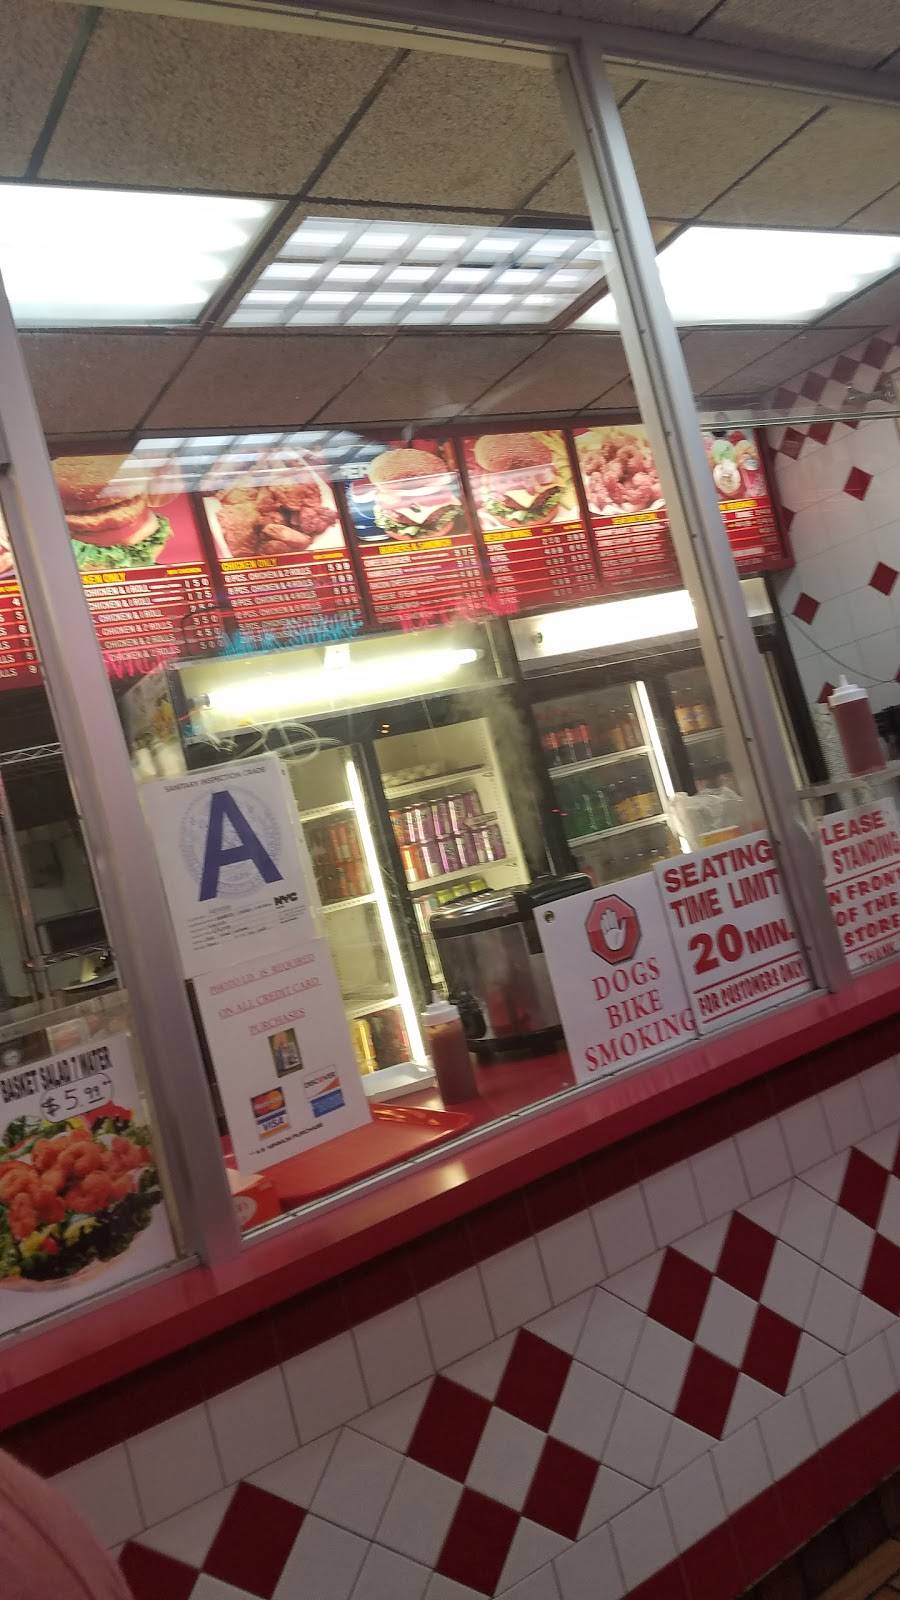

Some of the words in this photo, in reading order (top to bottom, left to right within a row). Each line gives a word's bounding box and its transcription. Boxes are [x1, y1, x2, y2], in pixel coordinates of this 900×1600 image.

[199, 790, 284, 902] A
[662, 840, 777, 893] SEATING
[274, 892, 298, 906] NYC
[670, 888, 723, 928] TIME
[727, 868, 780, 909] LIMIT
[836, 907, 858, 926] OF
[863, 891, 899, 915] THE
[688, 923, 744, 975] 20
[744, 918, 797, 955] MIN.
[591, 957, 661, 1001] DOGS
[698, 992, 721, 1016] FOR
[720, 968, 780, 1006] CUSTOMERS
[605, 989, 664, 1030] BIKE
[584, 1007, 698, 1073] SMOKING
[262, 1117, 284, 1131] VISA
